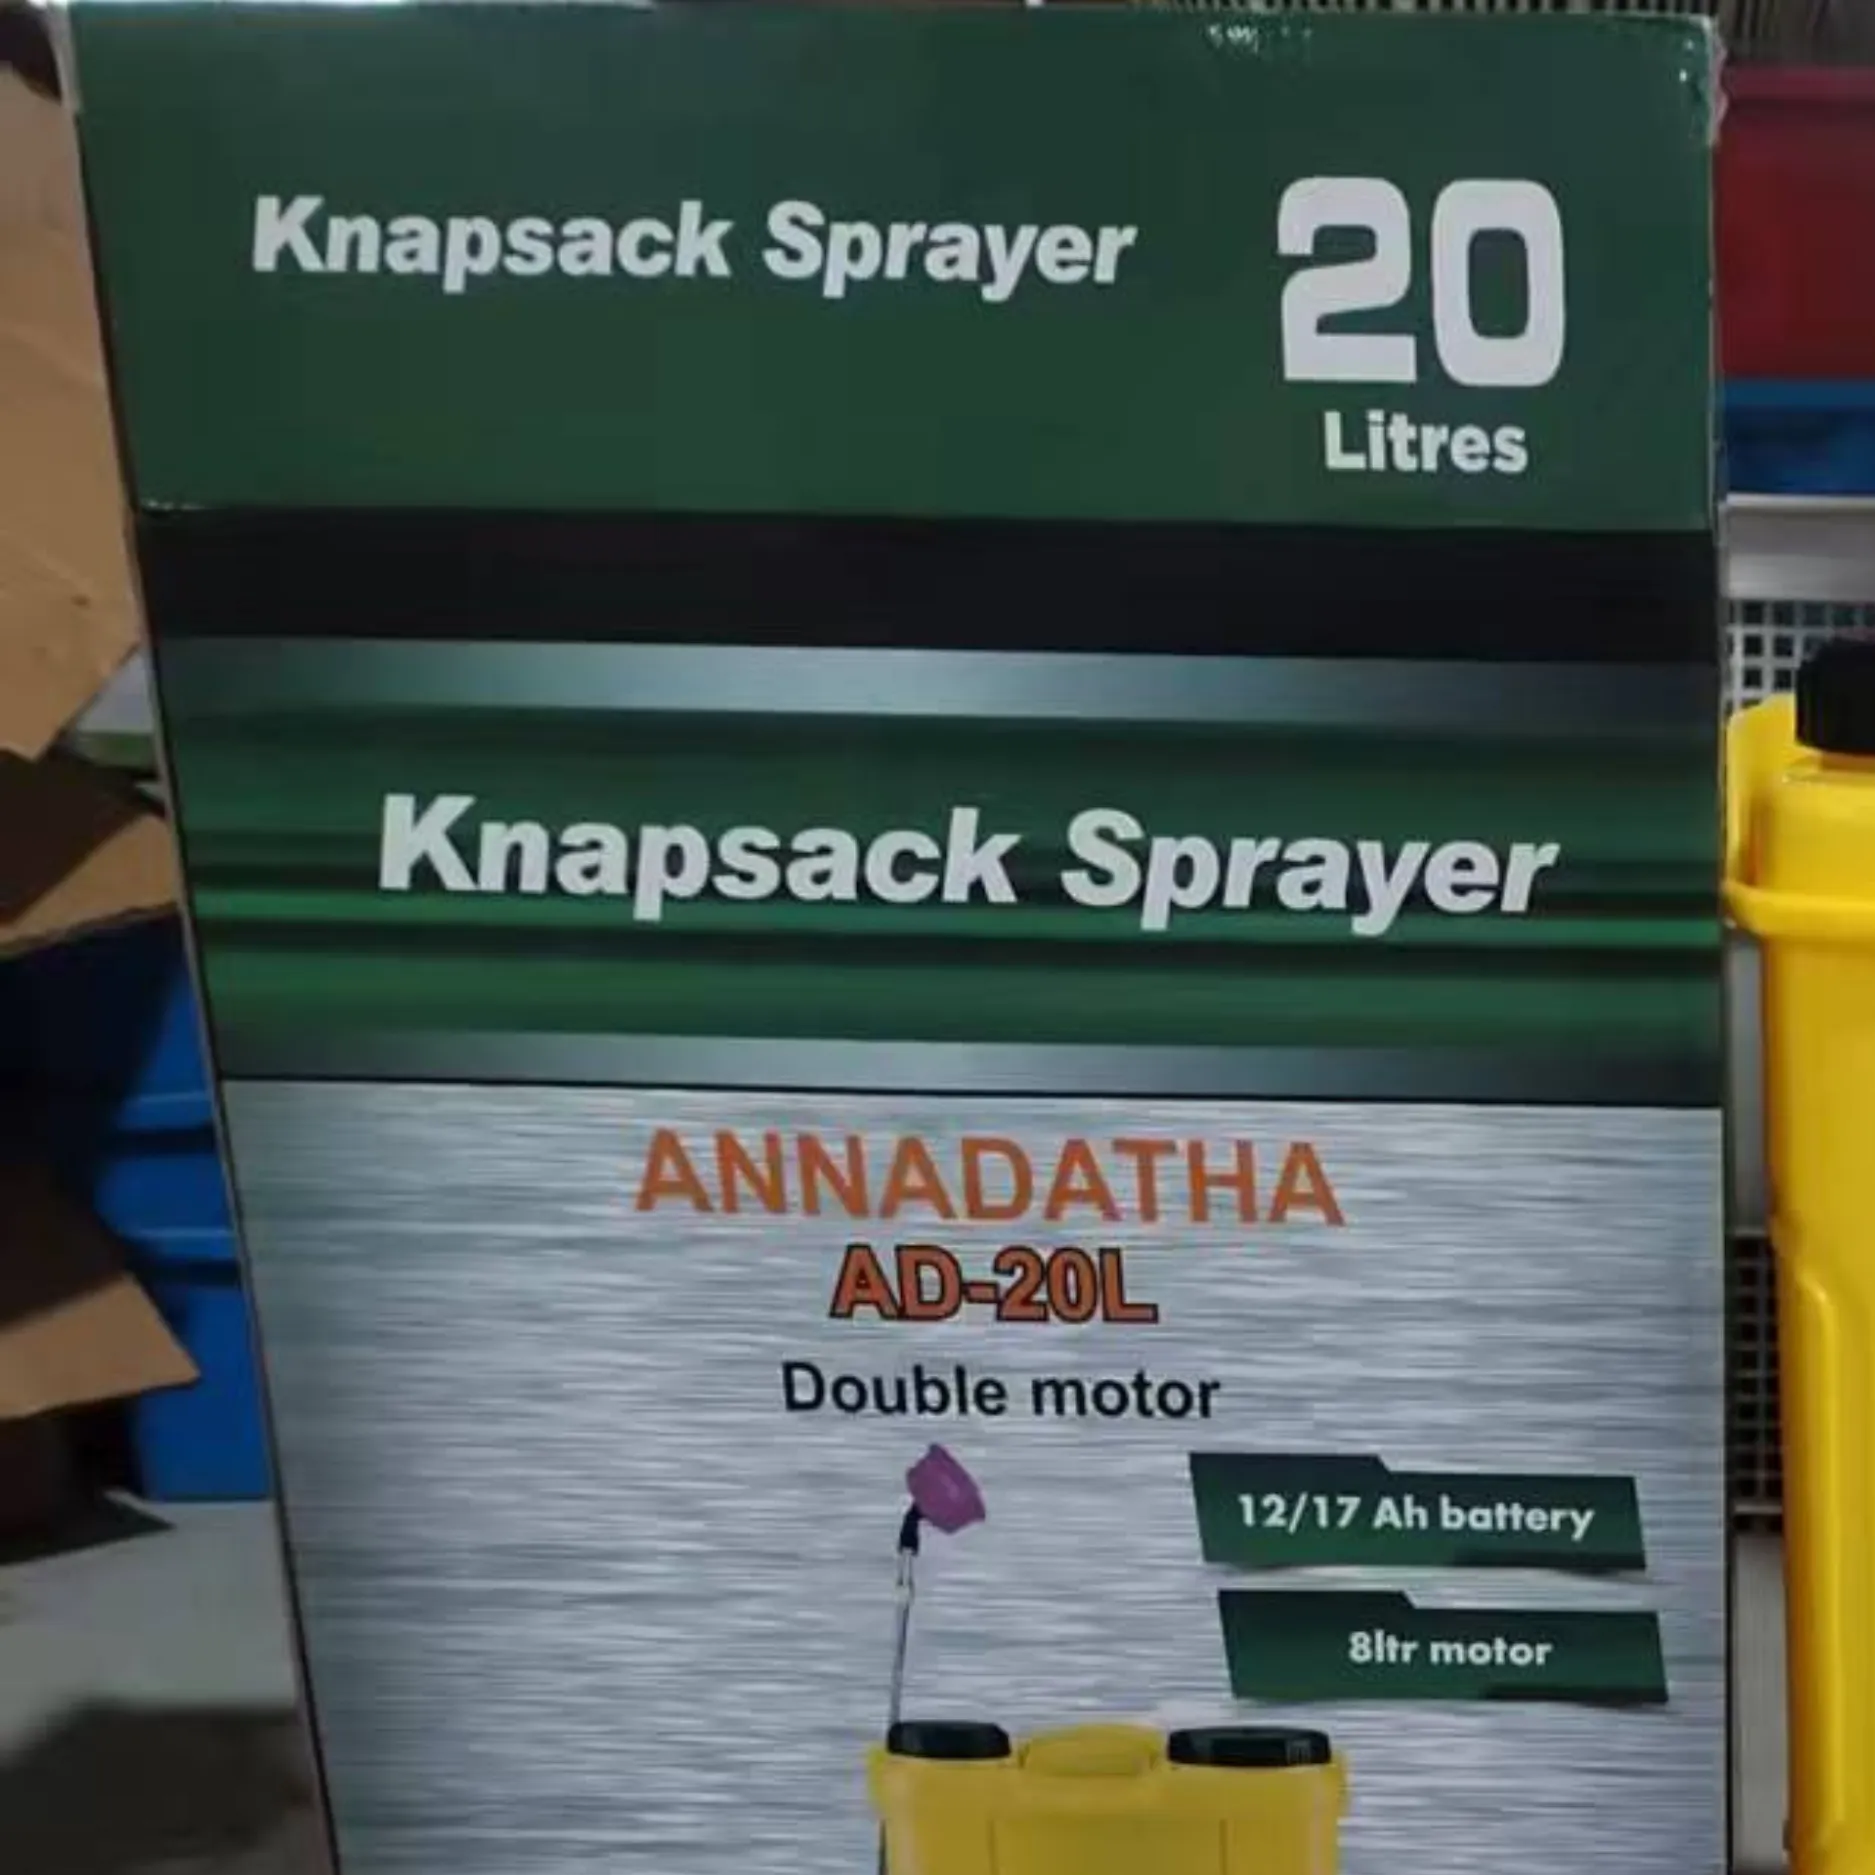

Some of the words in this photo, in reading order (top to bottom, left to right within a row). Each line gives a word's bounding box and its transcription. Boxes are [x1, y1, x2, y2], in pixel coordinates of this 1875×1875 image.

[252, 194, 734, 295] Knapsack
[761, 199, 1140, 303] Sprayer
[1276, 175, 1566, 388] 20
[1323, 408, 1529, 474] Litres
[378, 793, 1023, 923] Knapsack
[1059, 807, 1562, 938] Sprayer
[635, 1128, 1346, 1228] ANNADATHA
[829, 1243, 1159, 1325] AD-20L
[780, 1359, 1009, 1417] Double
[1030, 1368, 1223, 1421] motor
[1237, 1492, 1362, 1535] 12/17
[1372, 1493, 1430, 1531] Ah
[1439, 1493, 1596, 1542] battery
[1347, 1628, 1420, 1665] 8ltr
[1429, 1636, 1553, 1667] motor
